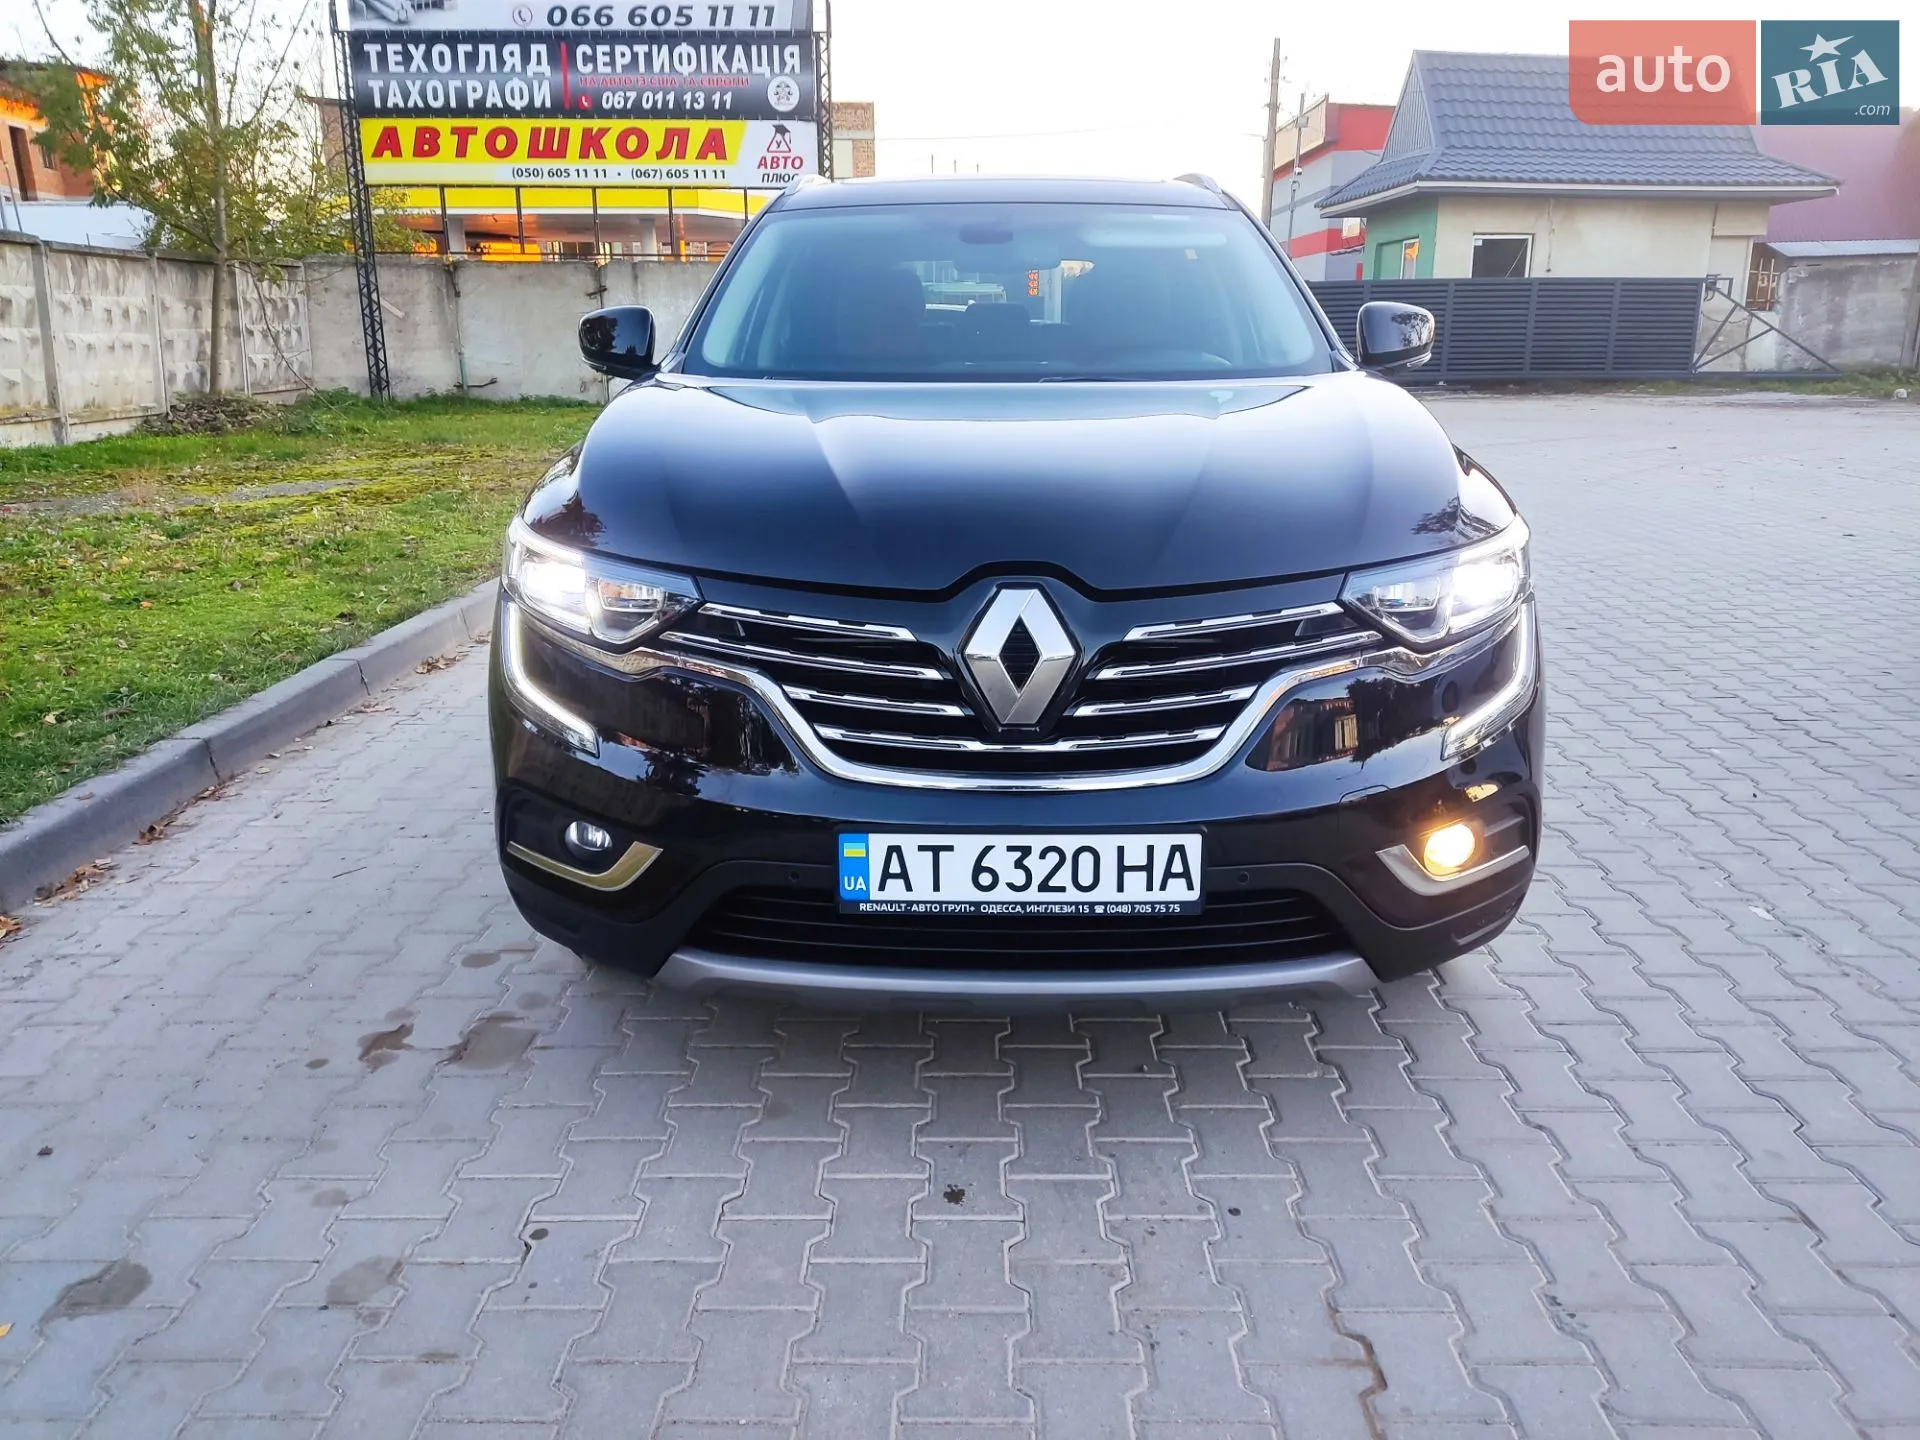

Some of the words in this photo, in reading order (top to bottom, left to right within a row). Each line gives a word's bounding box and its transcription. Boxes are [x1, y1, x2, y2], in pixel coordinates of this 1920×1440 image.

[547, 5, 613, 27] 066
[628, 5, 693, 27] 605
[708, 5, 734, 27] 11
[750, 5, 776, 27] 11
[363, 43, 551, 78] ТЕХОГЛЯД
[576, 42, 800, 78] СЕРТИФІКАЦІЯ
[579, 75, 597, 88] НА
[600, 75, 633, 88] АВТО
[650, 75, 677, 88] США
[368, 77, 551, 110] ТАХОГРАФИ
[602, 90, 637, 110] 067
[642, 90, 675, 110] 011
[683, 90, 705, 110] 13
[712, 90, 732, 110] 11
[371, 126, 728, 160] АВТОШКОЛА
[757, 156, 803, 170] АВТО
[512, 168, 544, 179] (050)
[547, 168, 570, 178] 605
[574, 168, 588, 178] 11
[593, 168, 607, 178] 11
[631, 168, 662, 180] (067)
[666, 169, 689, 179] 605
[693, 169, 707, 179] 11
[712, 169, 726, 179] 11
[878, 844, 954, 892] AT
[971, 845, 1100, 893] 6320
[1116, 844, 1194, 892] HA
[844, 876, 867, 891] UA
[942, 903, 975, 913] ГРУП+
[981, 904, 1024, 914] ОДЕССА,
[1026, 904, 1075, 913] ИНГЛЕЗИ
[1078, 904, 1089, 913] 15
[1107, 904, 1131, 914] (048)
[1134, 904, 1151, 913] 705
[1154, 904, 1166, 913] 75
[1168, 904, 1180, 913] 75
